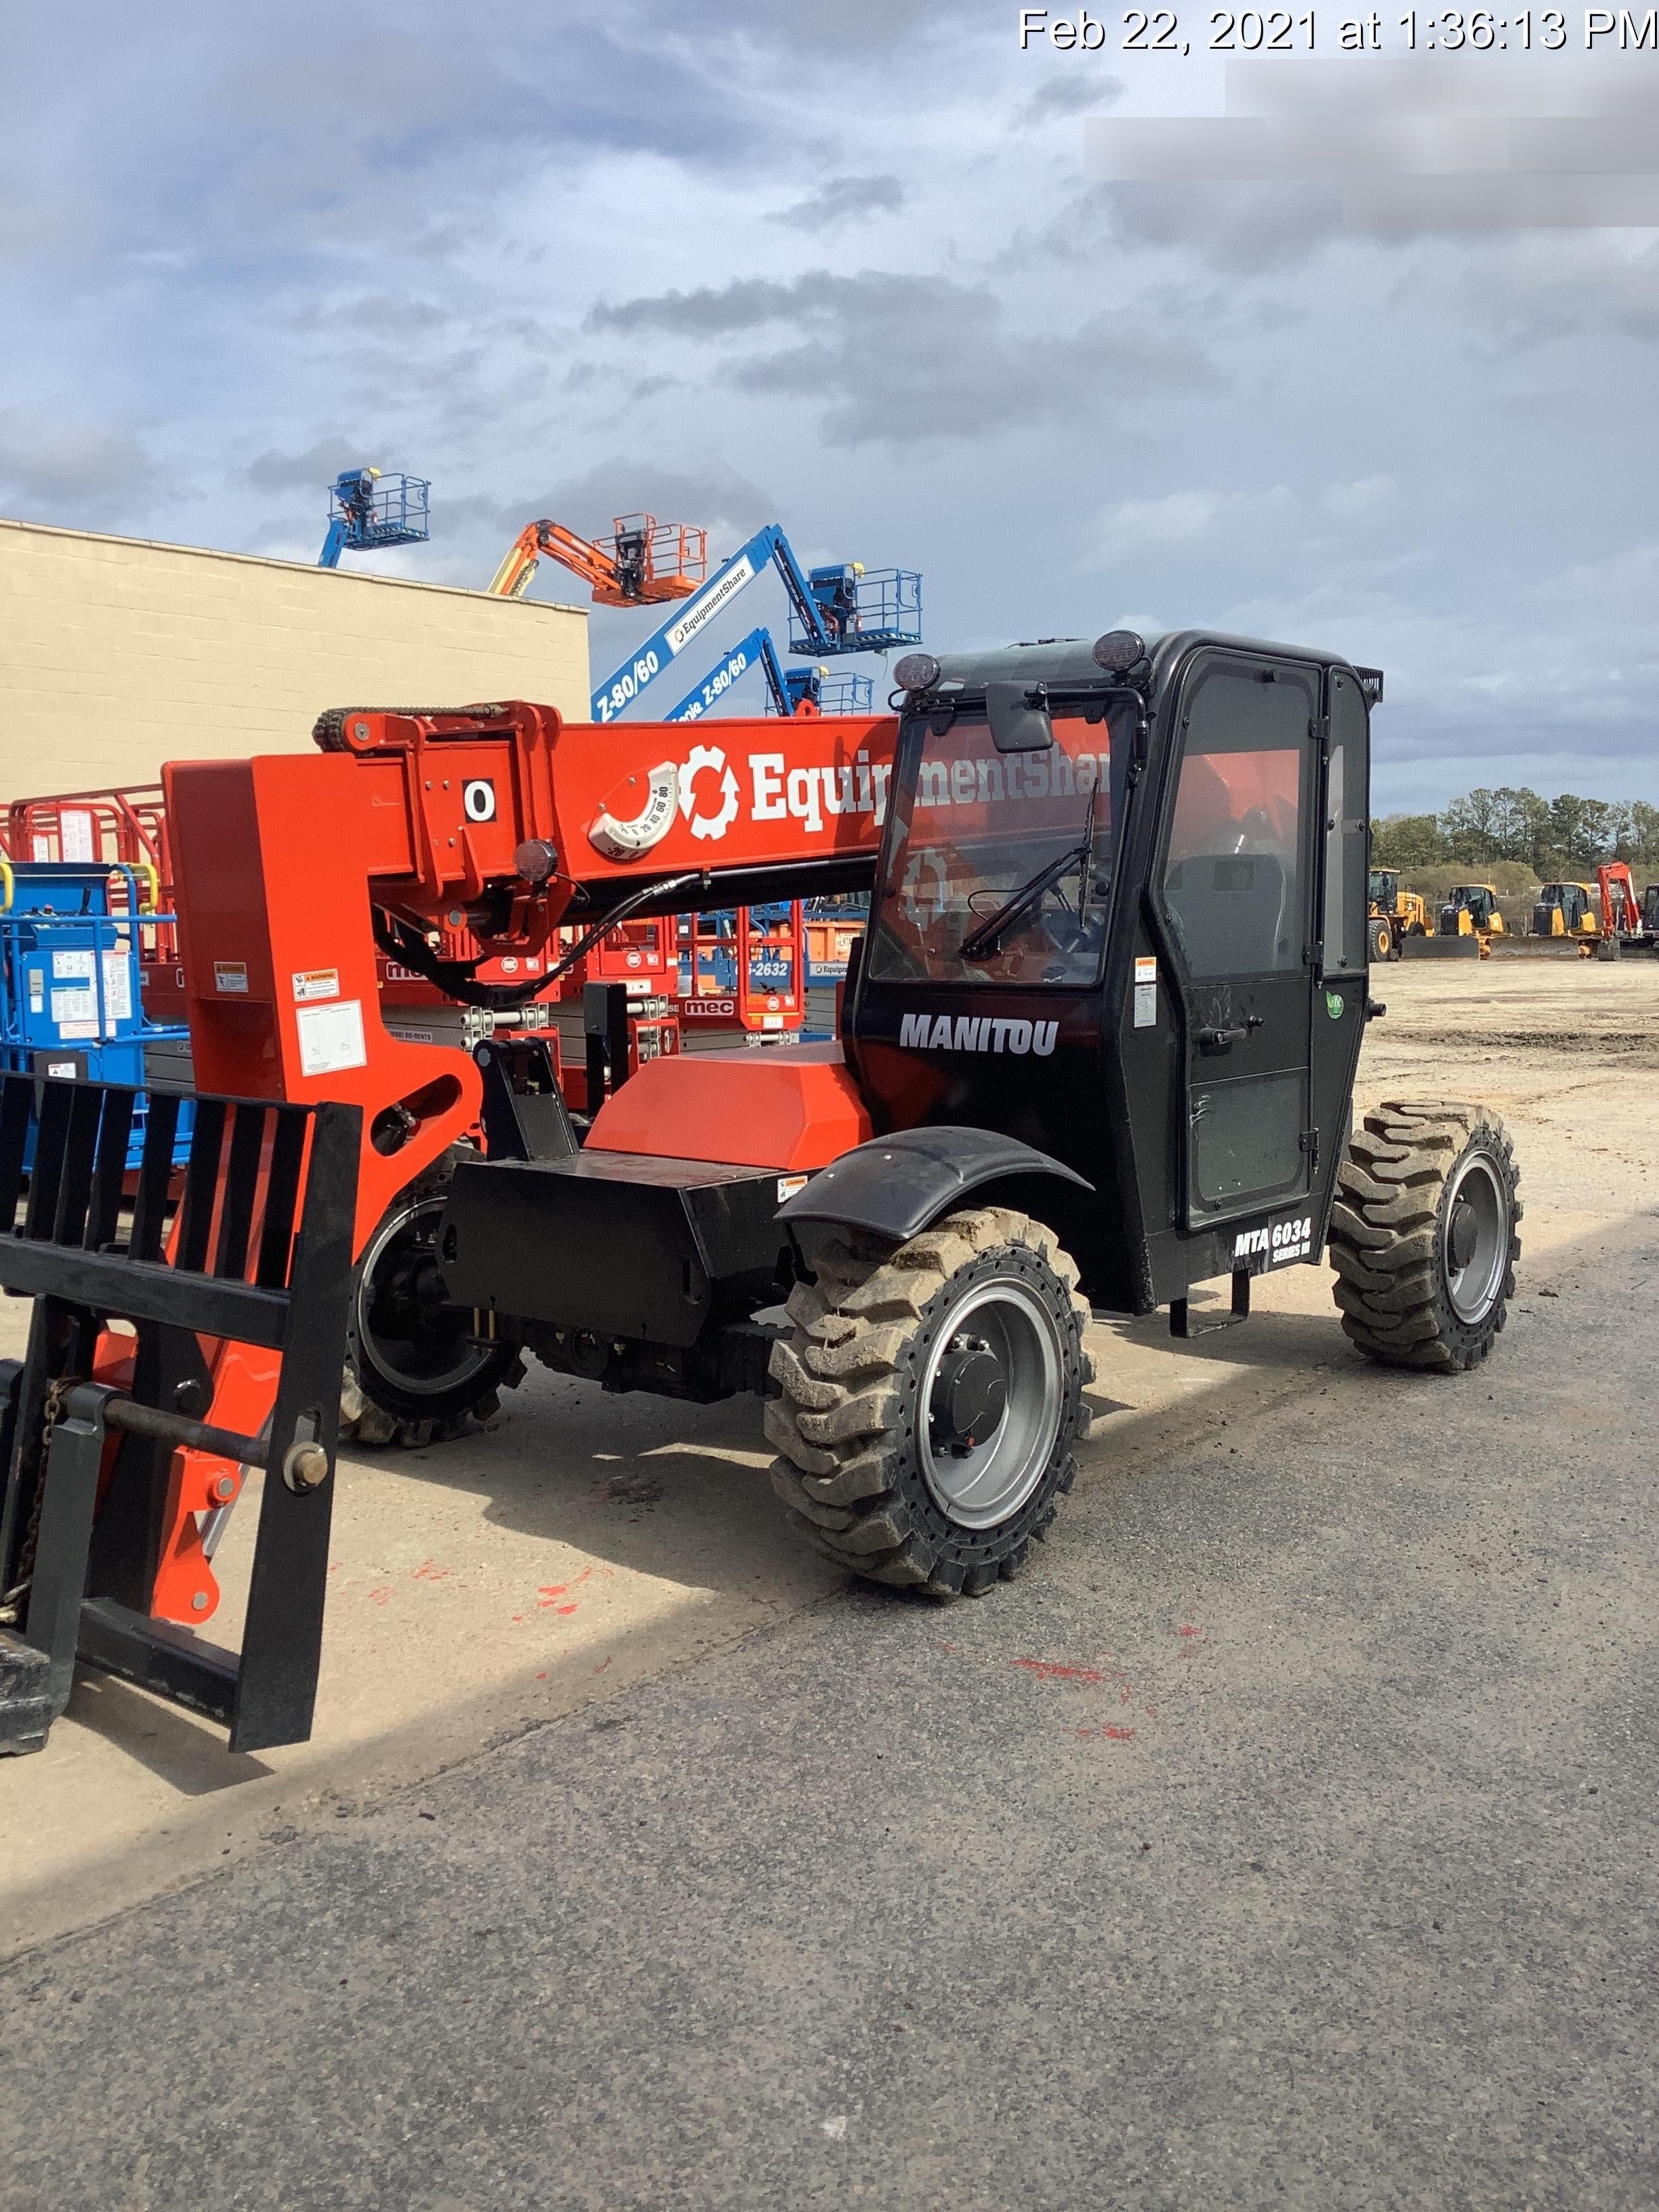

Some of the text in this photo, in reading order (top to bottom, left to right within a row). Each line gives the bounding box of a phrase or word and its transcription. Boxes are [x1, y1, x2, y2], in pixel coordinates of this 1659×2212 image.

[683, 568, 746, 635] EquipmentShare
[597, 651, 659, 722] Z-80/60
[702, 652, 747, 706] Z-80/60
[464, 781, 495, 821] 0
[655, 801, 666, 813] 60
[659, 786, 668, 798] 80
[640, 823, 651, 833] 20
[650, 815, 661, 825] 40
[686, 1002, 733, 1014] mec
[900, 1013, 1059, 1057] MANITOU
[1235, 1217, 1311, 1257] MTA 6034
[1273, 1241, 1311, 1263] SERIES III
